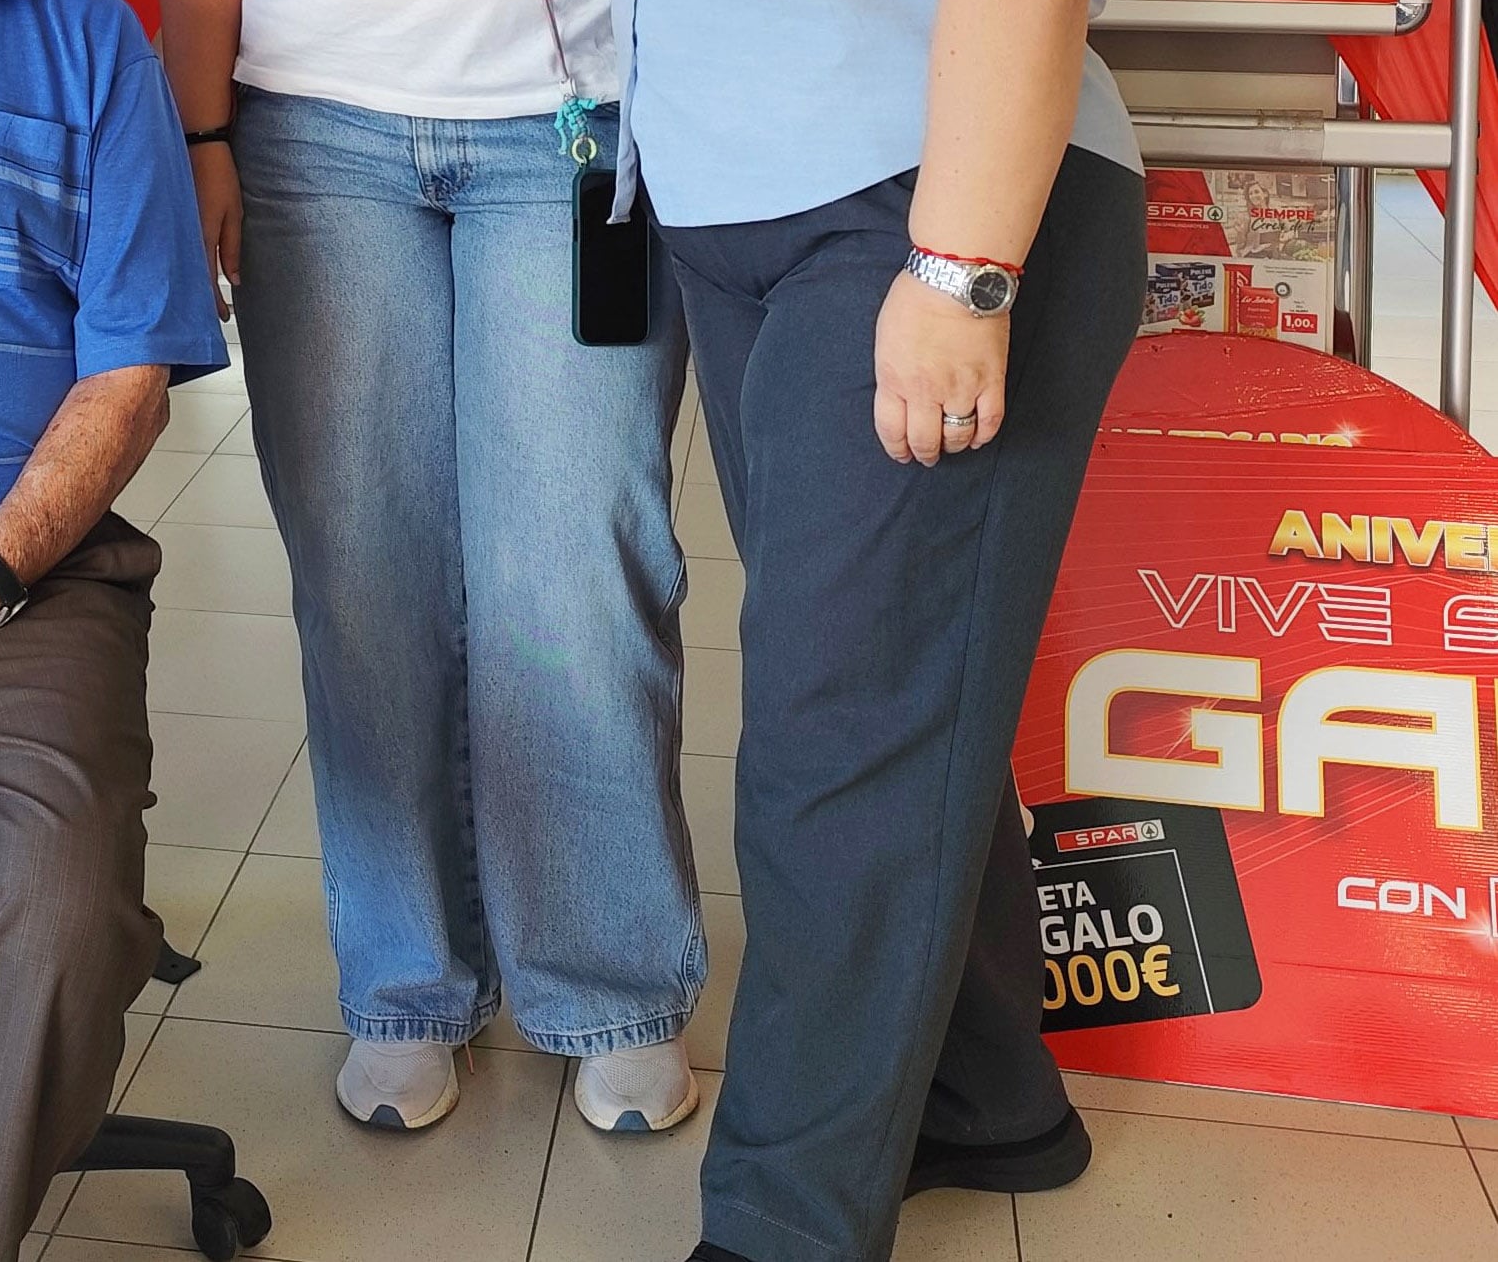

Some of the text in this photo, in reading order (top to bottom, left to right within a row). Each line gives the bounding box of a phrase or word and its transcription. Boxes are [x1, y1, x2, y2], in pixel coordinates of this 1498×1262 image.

[1147, 205, 1203, 218] SPAR
[1250, 207, 1315, 221] SIEMPRE
[1267, 509, 1498, 572] ANIVE
[1137, 568, 1498, 652] VIVE S
[1064, 647, 1498, 834] GA
[1075, 826, 1137, 846] SPAR
[1037, 880, 1097, 912] ETA
[1337, 876, 1467, 920] CON
[1039, 904, 1164, 955] GALO
[1042, 944, 1181, 1010] 000€
